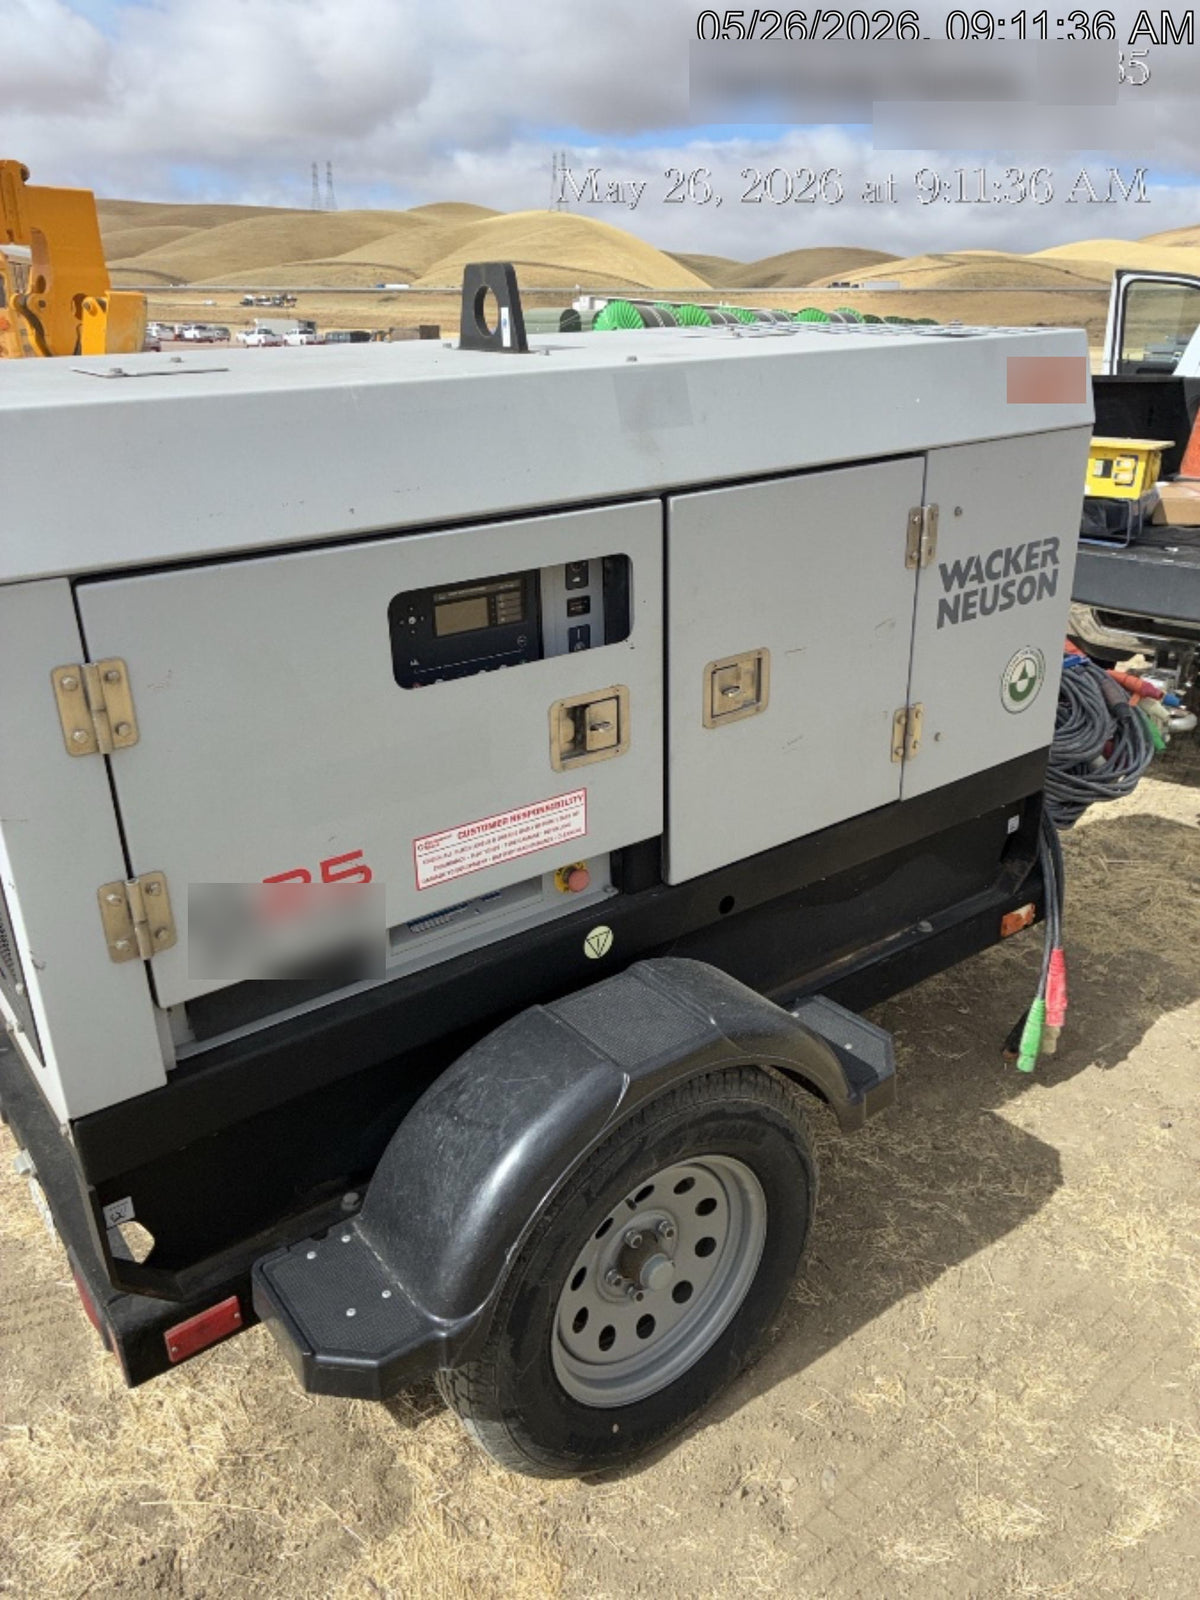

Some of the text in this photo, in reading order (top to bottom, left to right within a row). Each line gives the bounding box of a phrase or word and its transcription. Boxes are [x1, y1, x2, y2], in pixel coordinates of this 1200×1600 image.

[937, 536, 1061, 593] WACKER
[936, 568, 1060, 630] NEUSON
[457, 818, 509, 839] CUSTOMER
[510, 795, 583, 822] RESPONSIBILITY
